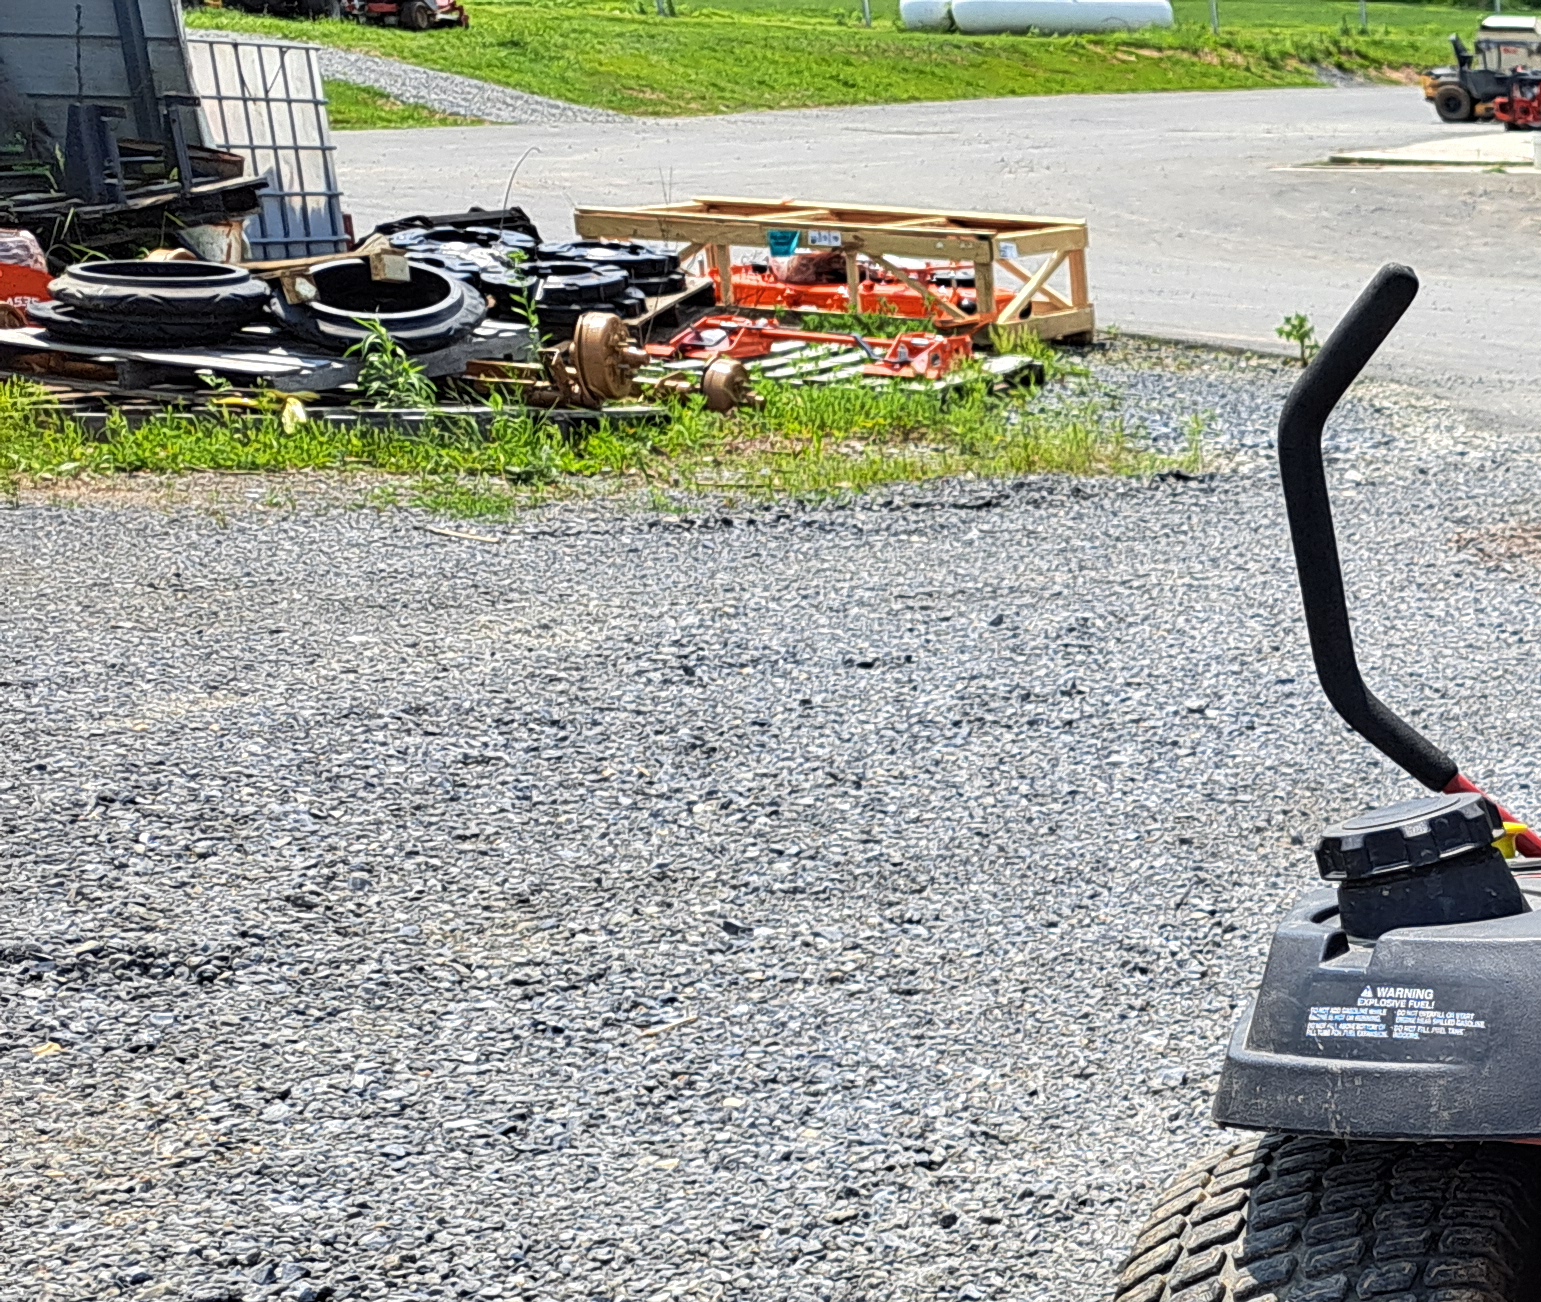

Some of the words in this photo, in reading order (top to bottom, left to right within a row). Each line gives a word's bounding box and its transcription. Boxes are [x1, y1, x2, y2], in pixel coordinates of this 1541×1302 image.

[1376, 987, 1434, 1000] WARNING
[1357, 998, 1406, 1008] EXPLOSIVE
[1408, 999, 1435, 1009] FUEL!
